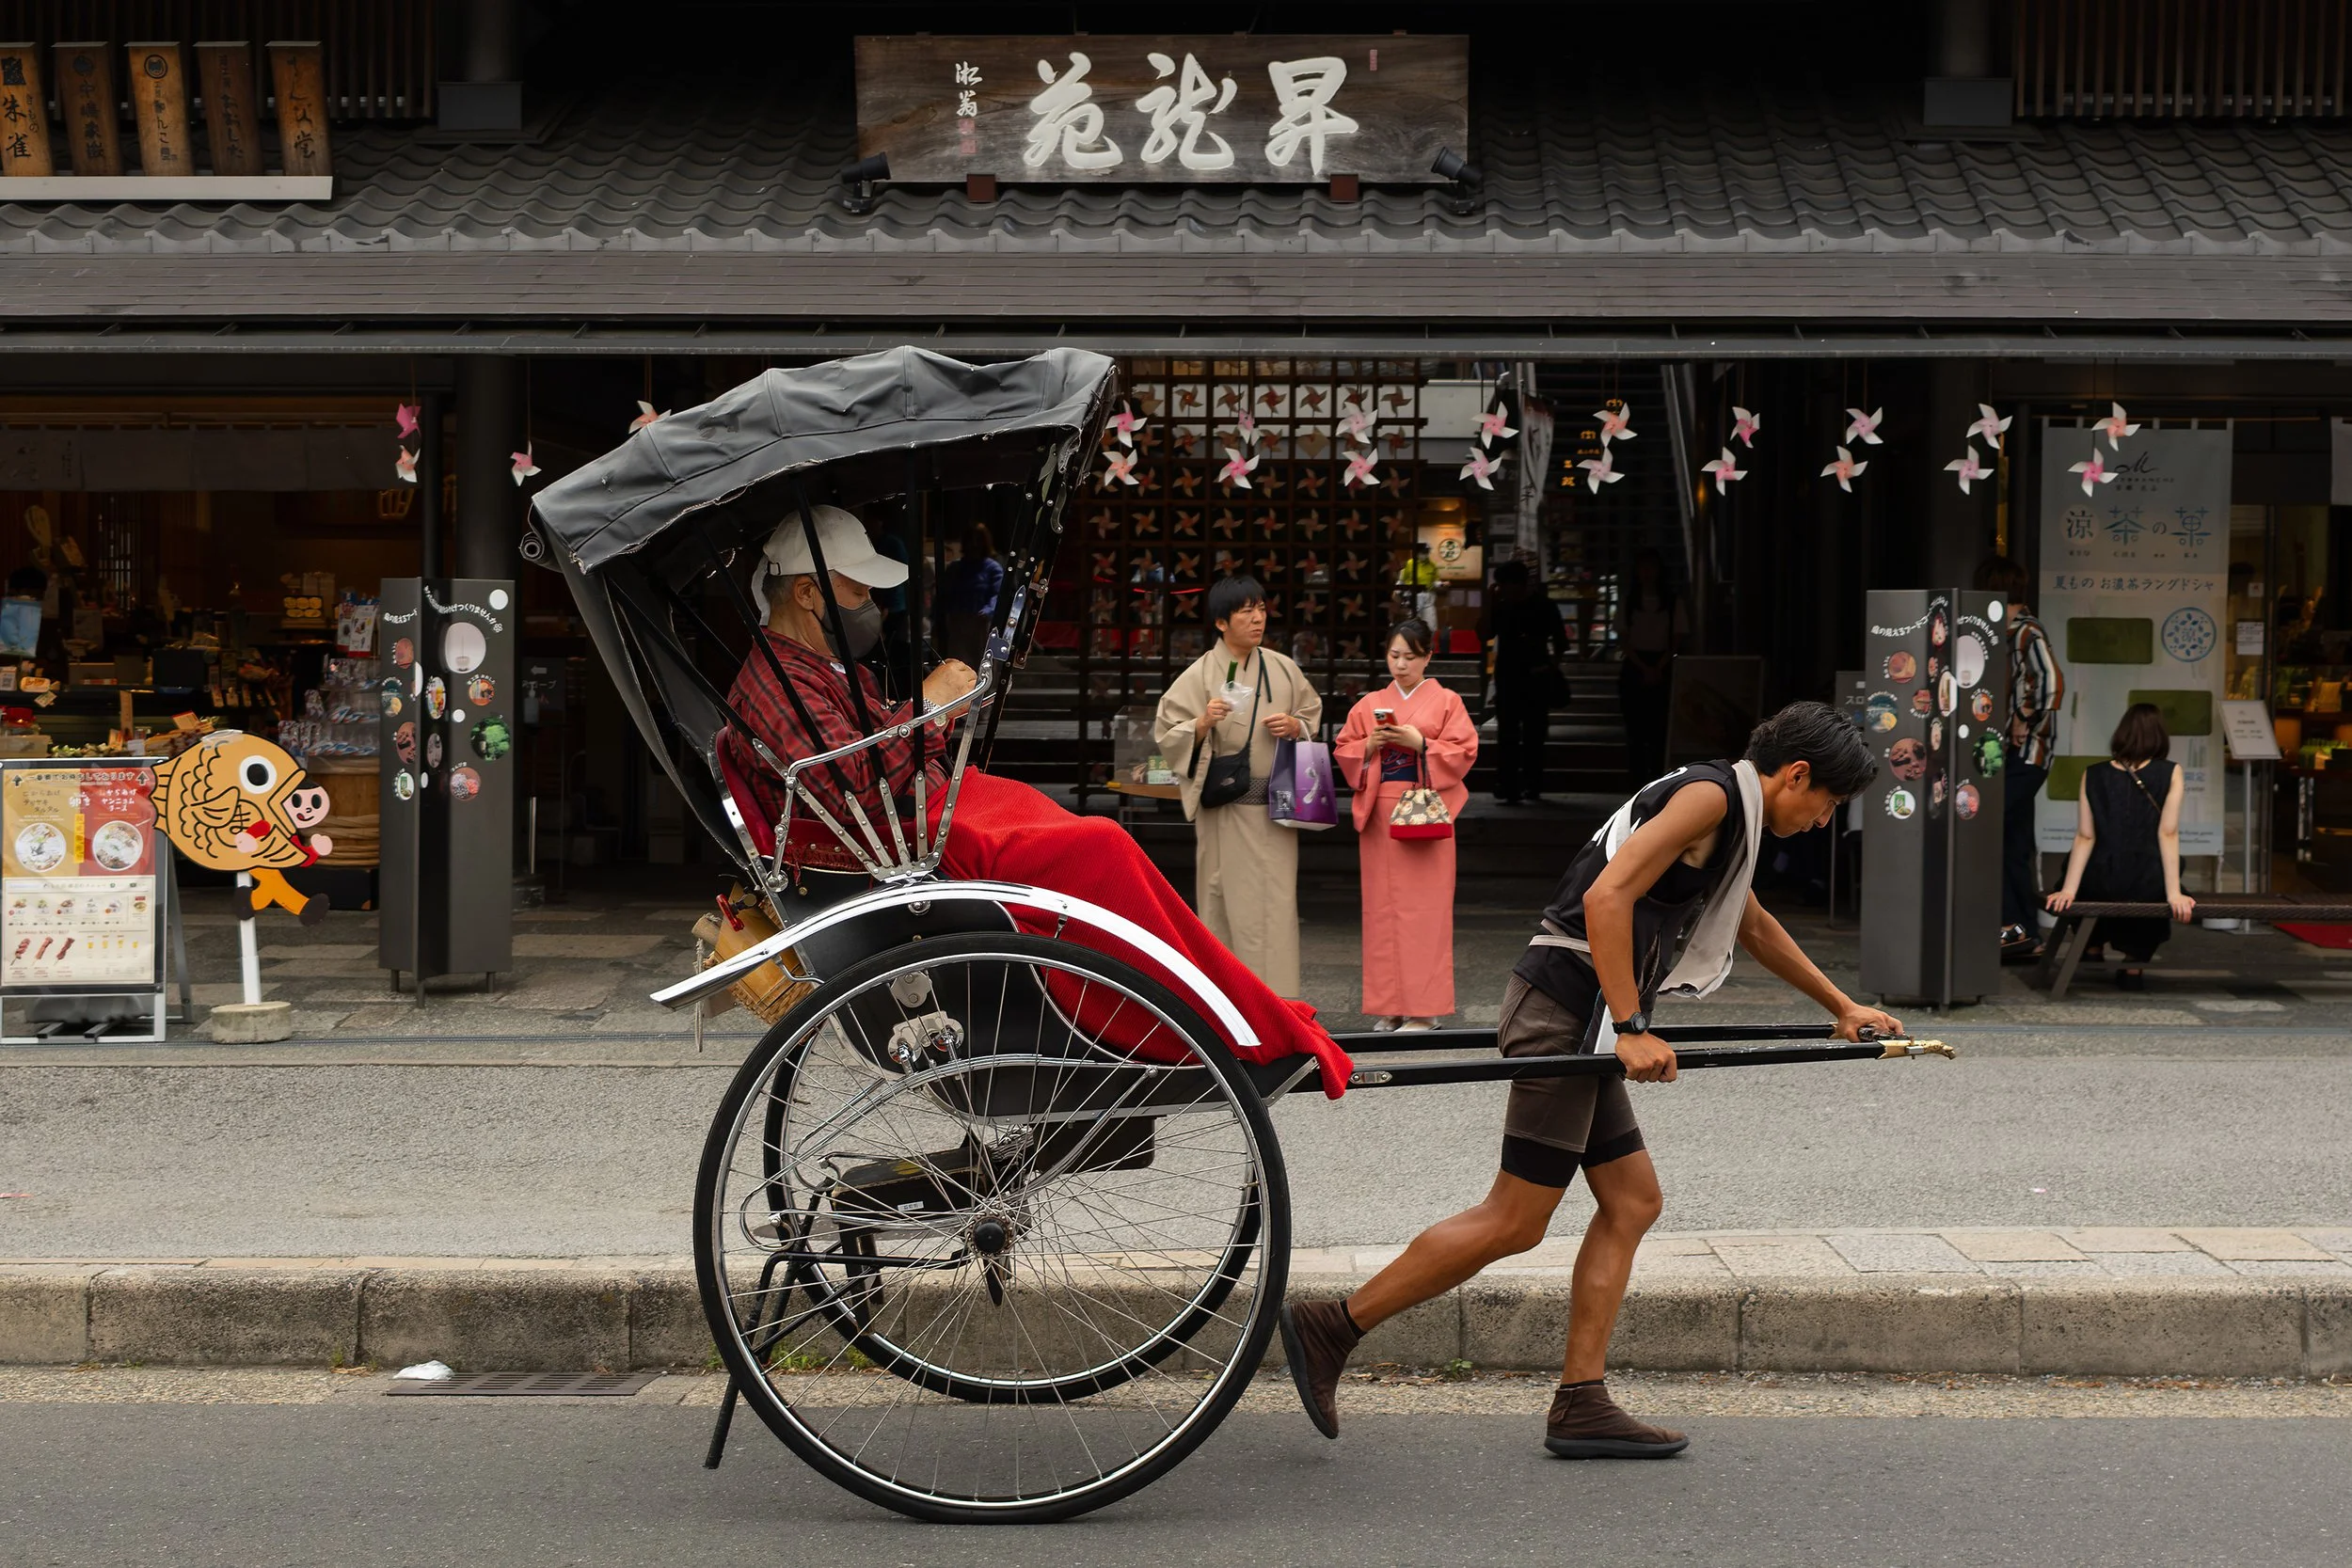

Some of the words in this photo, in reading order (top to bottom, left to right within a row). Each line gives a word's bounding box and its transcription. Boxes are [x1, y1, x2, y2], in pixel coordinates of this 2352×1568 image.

[3, 94, 31, 158] 朱雀
[2053, 575, 2095, 591] 夏もの
[2100, 575, 2215, 591] お濃茶ラングドシャ
